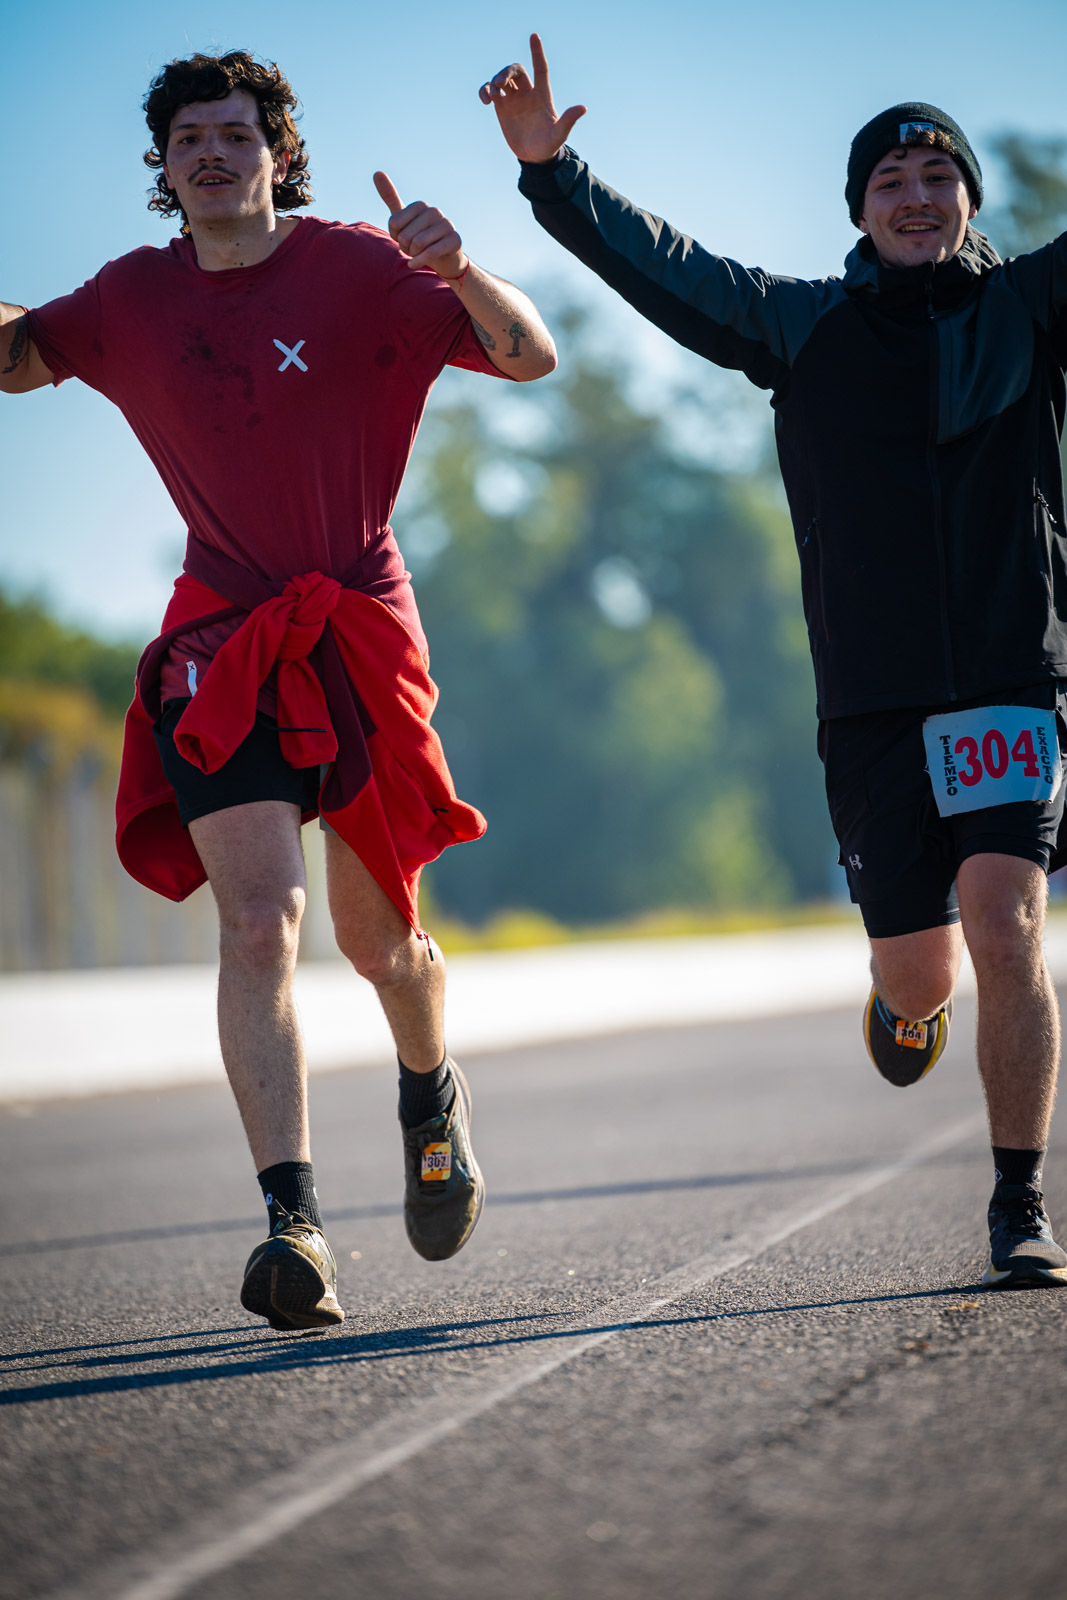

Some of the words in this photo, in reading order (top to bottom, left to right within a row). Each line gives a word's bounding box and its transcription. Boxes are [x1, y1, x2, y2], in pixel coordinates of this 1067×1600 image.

[939, 734, 958, 796] TIEMPO
[954, 728, 1041, 787] 304
[1035, 726, 1053, 785] EXACTO
[901, 1029, 921, 1041] 304
[427, 1156, 447, 1167] 307
